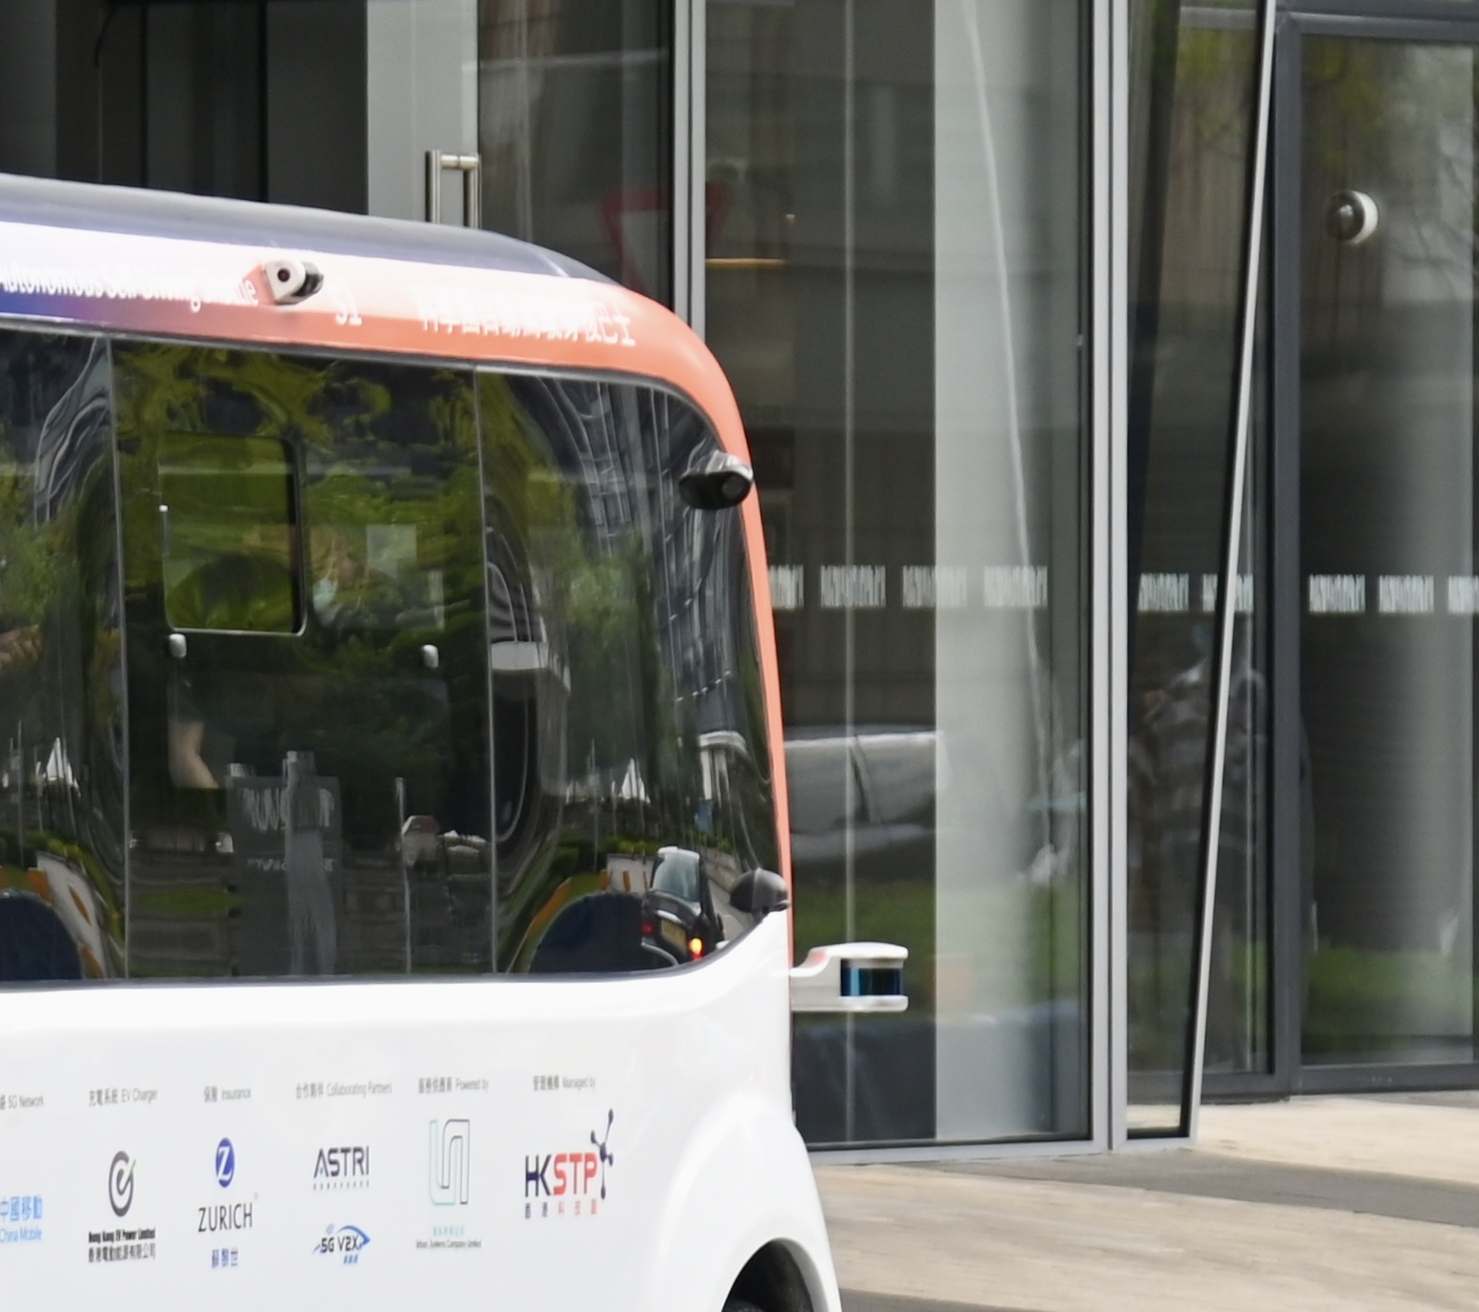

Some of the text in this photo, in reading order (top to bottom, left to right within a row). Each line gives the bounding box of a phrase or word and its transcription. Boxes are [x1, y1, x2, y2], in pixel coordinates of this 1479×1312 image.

[313, 1145, 370, 1179] ASTRI
[524, 1151, 598, 1198] HKSTP
[197, 1201, 253, 1233] ZURICH
[0, 1225, 43, 1243] China Mobile
[320, 1236, 335, 1254] 5G
